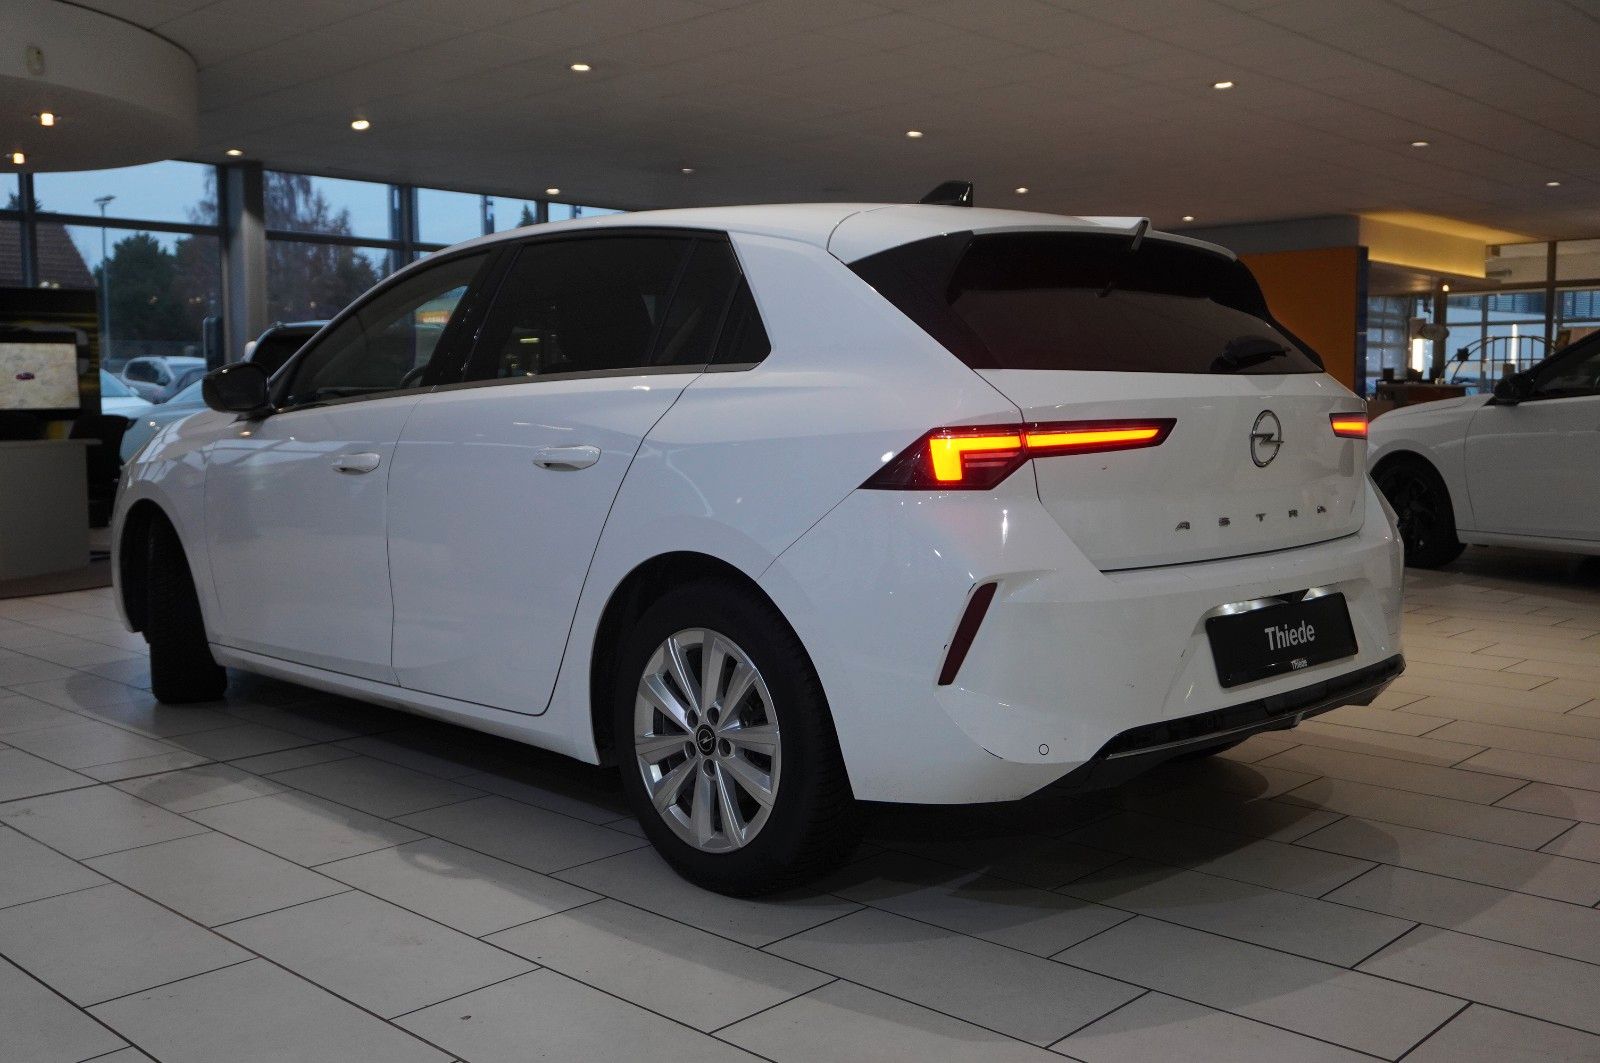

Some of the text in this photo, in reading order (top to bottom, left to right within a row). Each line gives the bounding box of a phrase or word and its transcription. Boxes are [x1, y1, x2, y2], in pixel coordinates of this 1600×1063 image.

[1175, 505, 1327, 531] ASTRA
[1264, 620, 1315, 650] Thiede
[1290, 658, 1308, 670] Thiede
